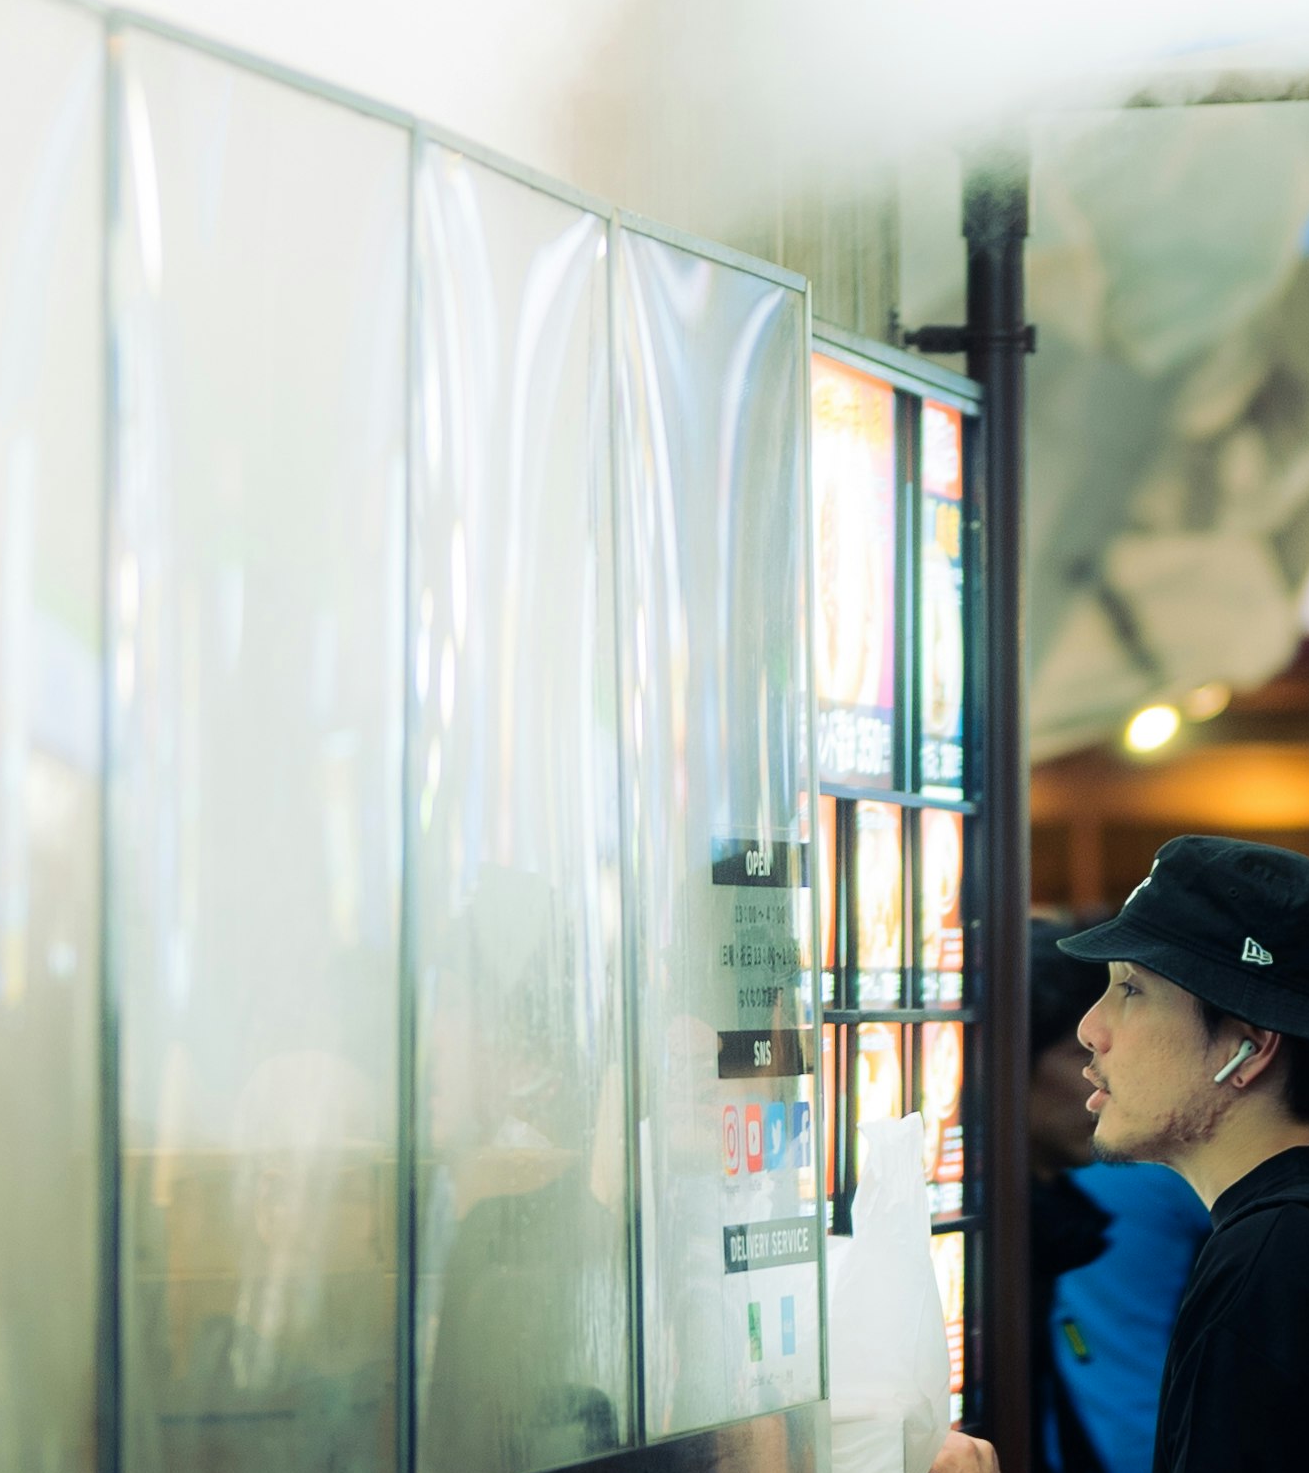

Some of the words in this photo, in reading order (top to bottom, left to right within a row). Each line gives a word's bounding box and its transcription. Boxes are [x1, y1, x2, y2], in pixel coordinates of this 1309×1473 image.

[745, 849, 771, 877] OPEN
[753, 1039, 772, 1067] SNS
[730, 1231, 769, 1262] DELIVERY
[772, 1227, 809, 1255] SERVICE
